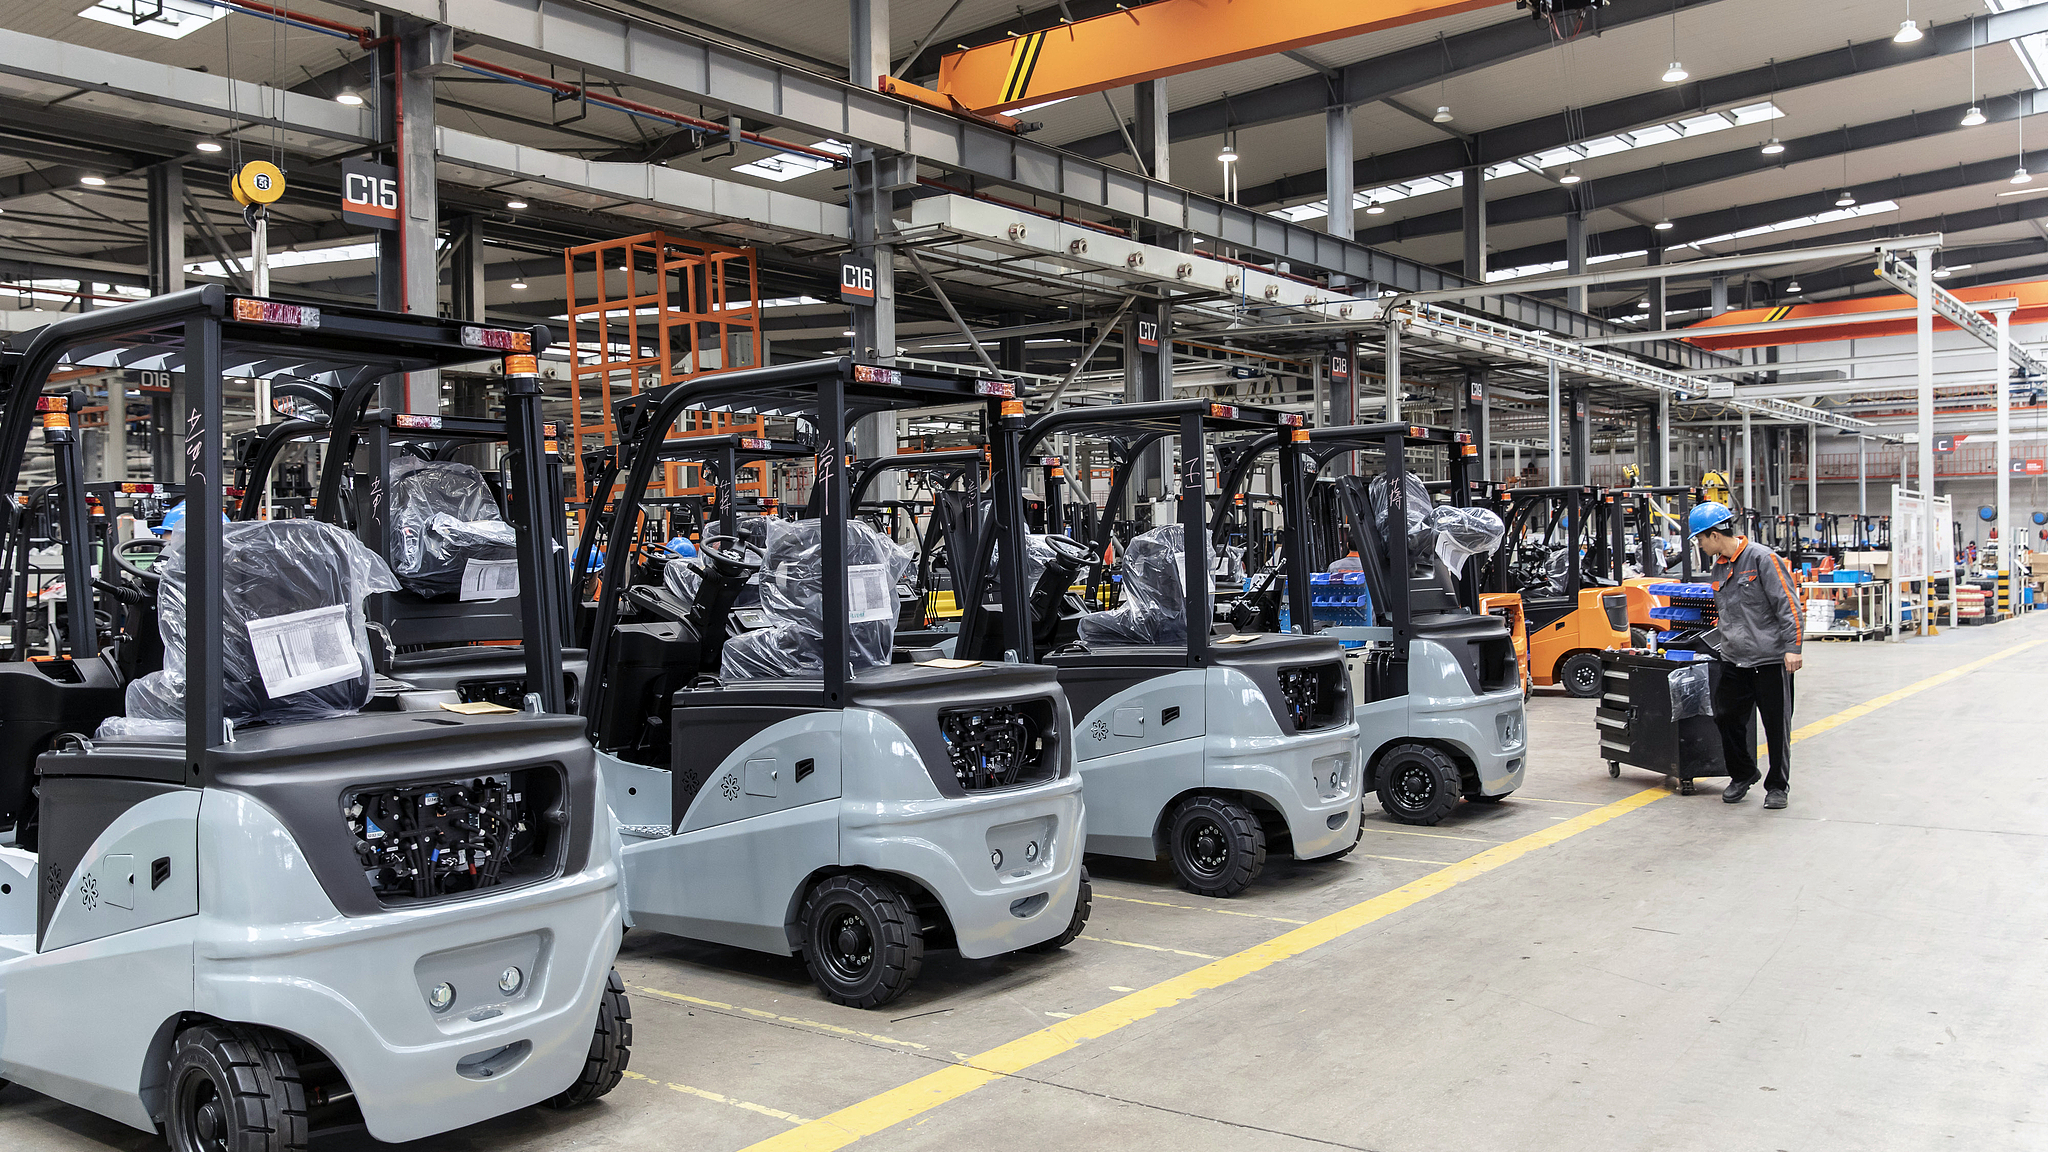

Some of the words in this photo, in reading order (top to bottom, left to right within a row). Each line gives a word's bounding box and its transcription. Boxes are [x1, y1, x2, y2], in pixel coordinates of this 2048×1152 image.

[346, 173, 397, 210] C15
[843, 264, 873, 291] C16
[1139, 321, 1157, 341] C17
[1332, 356, 1346, 373] C18
[141, 371, 170, 388] D16
[1938, 440, 1948, 451] C
[2013, 463, 2021, 472] C
